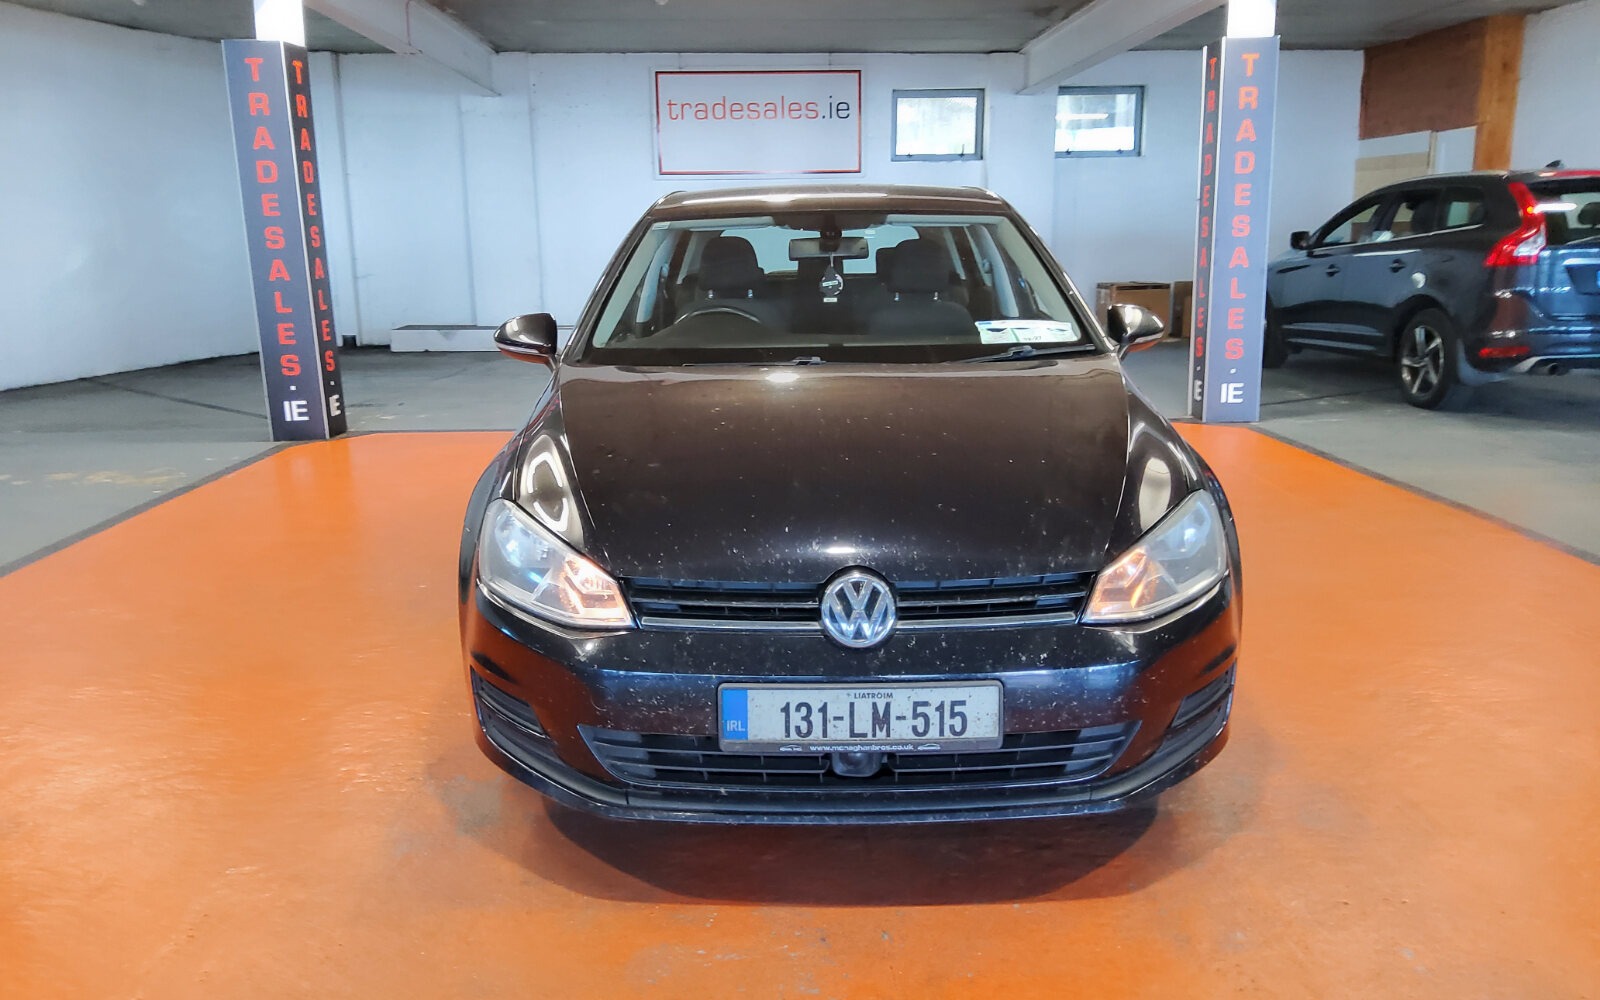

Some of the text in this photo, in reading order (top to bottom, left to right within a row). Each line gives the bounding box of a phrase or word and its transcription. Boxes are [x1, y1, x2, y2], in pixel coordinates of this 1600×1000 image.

[667, 95, 850, 120] tradesales.ie
[726, 720, 746, 732] IRL
[779, 700, 968, 738] 131-LM-515
